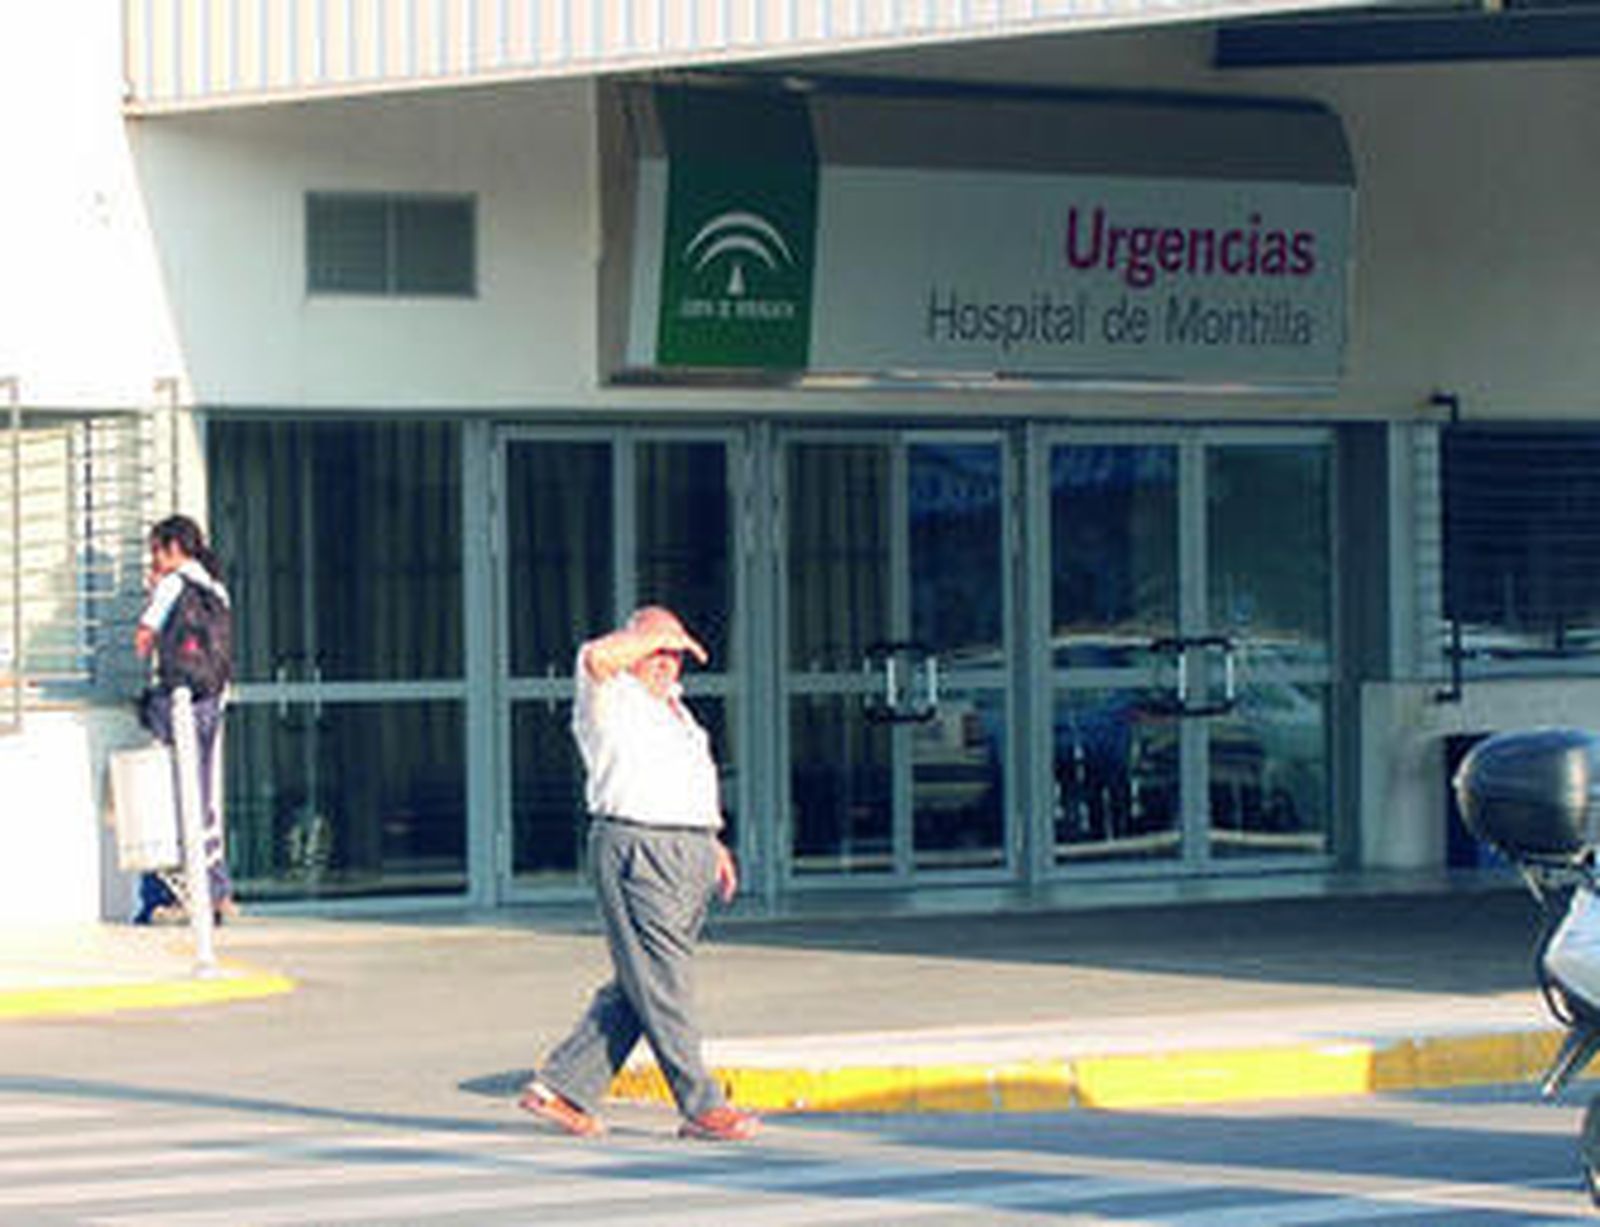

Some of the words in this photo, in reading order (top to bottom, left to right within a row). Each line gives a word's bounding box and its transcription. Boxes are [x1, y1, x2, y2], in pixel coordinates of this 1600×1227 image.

[1065, 206, 1316, 288] Urgencias
[927, 287, 1086, 351] Hospital
[1101, 297, 1150, 344] de
[1164, 297, 1312, 346] Montilla
